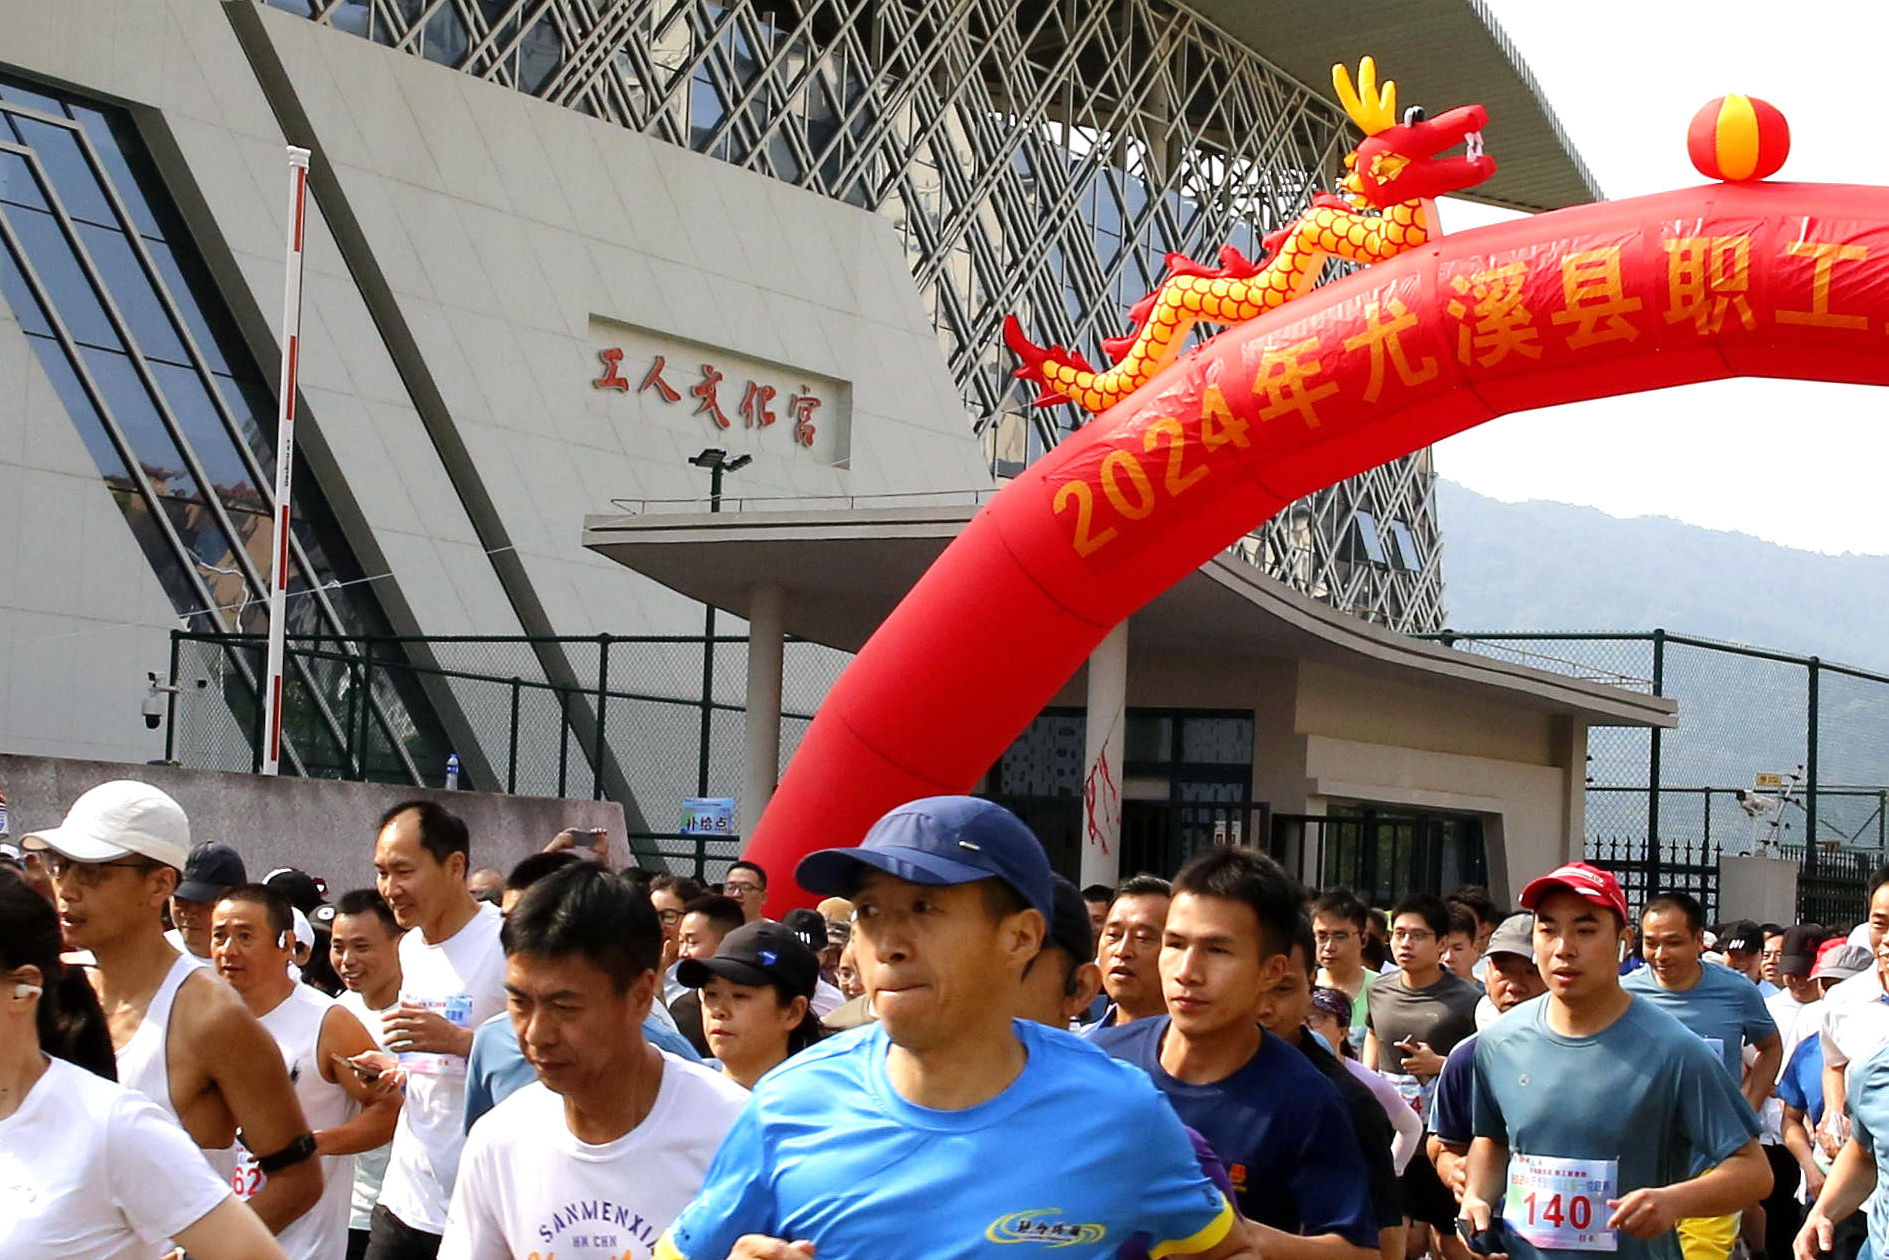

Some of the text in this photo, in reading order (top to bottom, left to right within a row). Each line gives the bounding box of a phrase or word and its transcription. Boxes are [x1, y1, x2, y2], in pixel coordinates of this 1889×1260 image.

[594, 347, 822, 447] 工人文化宫
[1052, 234, 1870, 560] 2024年尤溪县职工
[1523, 1191, 1592, 1231] 140
